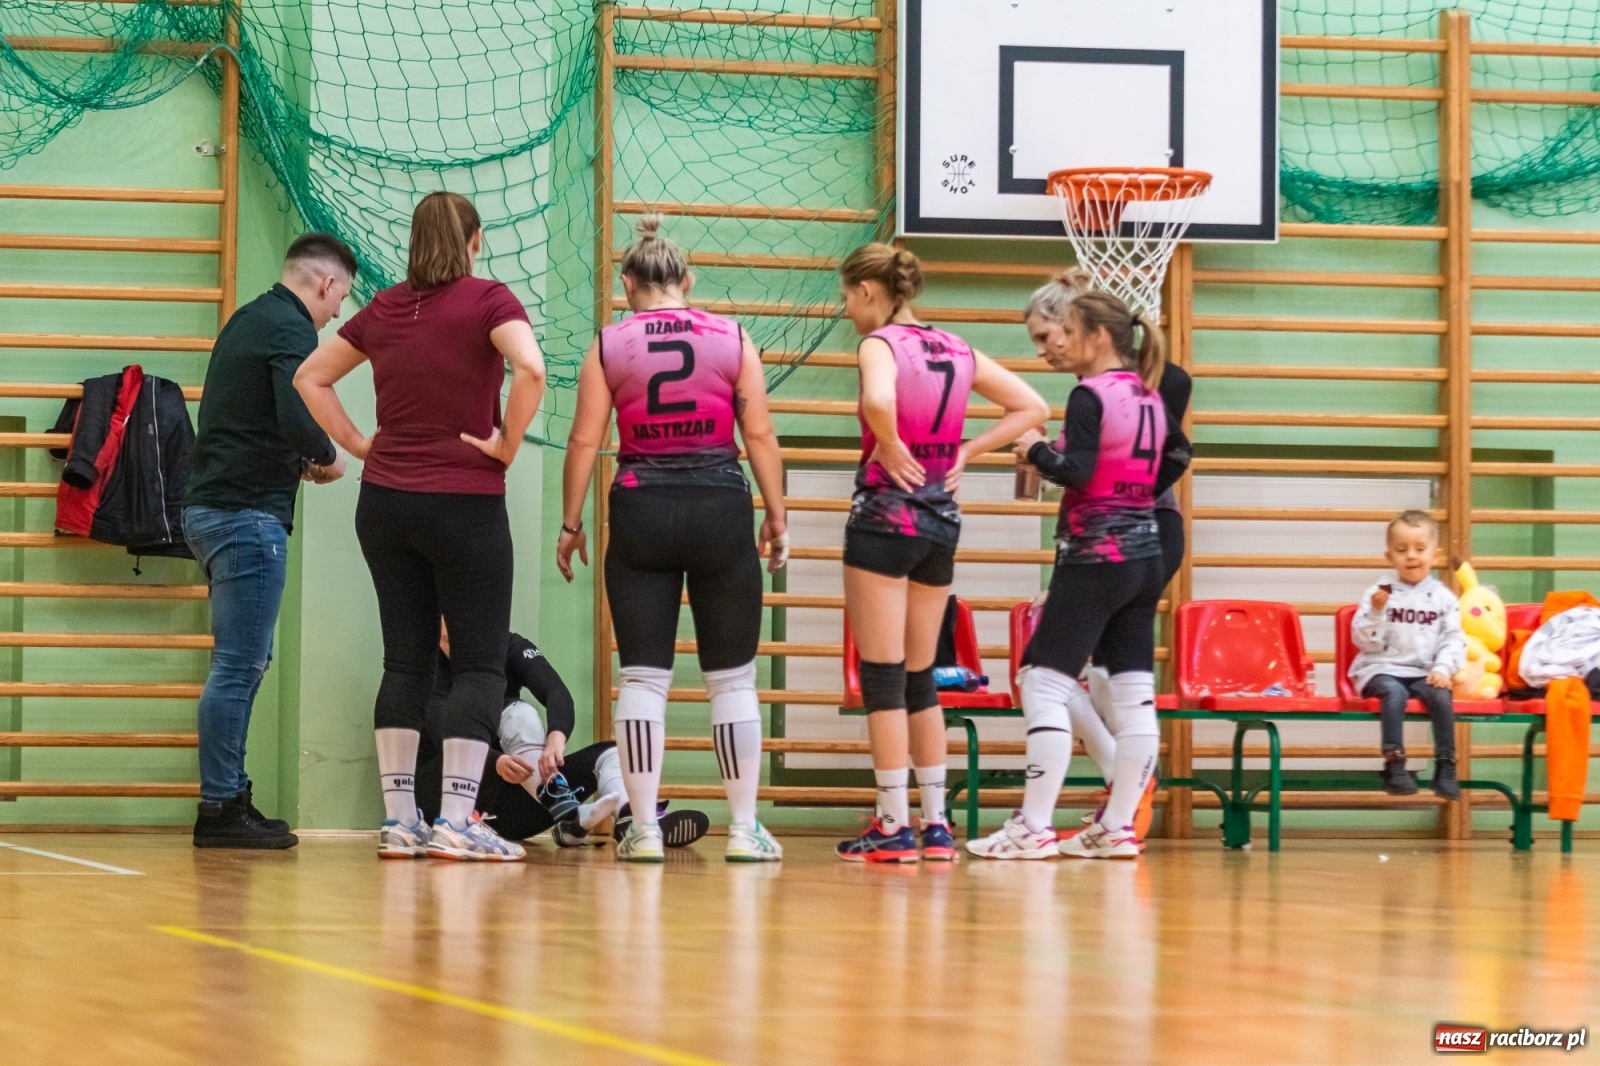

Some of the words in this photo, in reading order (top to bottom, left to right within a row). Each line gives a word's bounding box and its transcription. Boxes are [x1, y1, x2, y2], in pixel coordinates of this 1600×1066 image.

[942, 154, 976, 170] SURE
[941, 179, 976, 194] SHOT
[645, 320, 694, 335] DŻAGA
[647, 340, 697, 416] 2
[925, 360, 956, 435] 7
[1131, 404, 1157, 476] 4
[451, 781, 477, 793] gala
